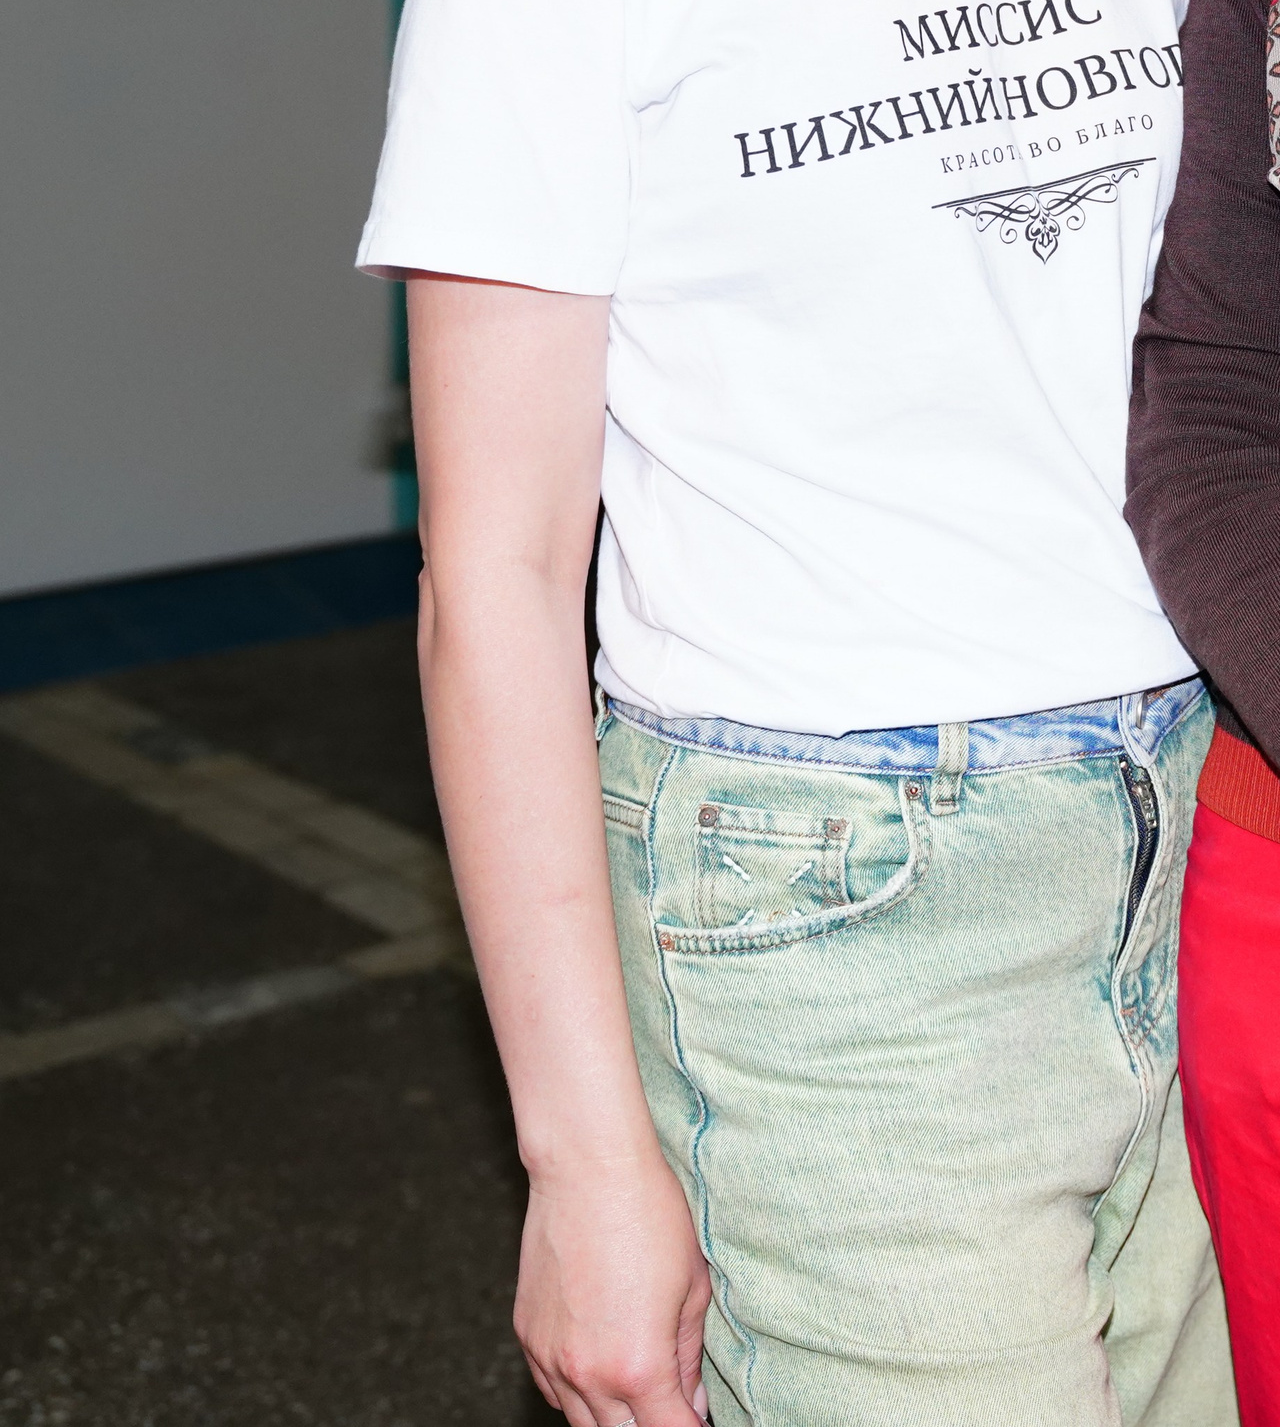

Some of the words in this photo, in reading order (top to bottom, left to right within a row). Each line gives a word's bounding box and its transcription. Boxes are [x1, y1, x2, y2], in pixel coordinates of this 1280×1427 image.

[941, 144, 1024, 174] КРАСОТ
[1027, 136, 1062, 159] ВО
[1075, 114, 1154, 145] БЛАГО
